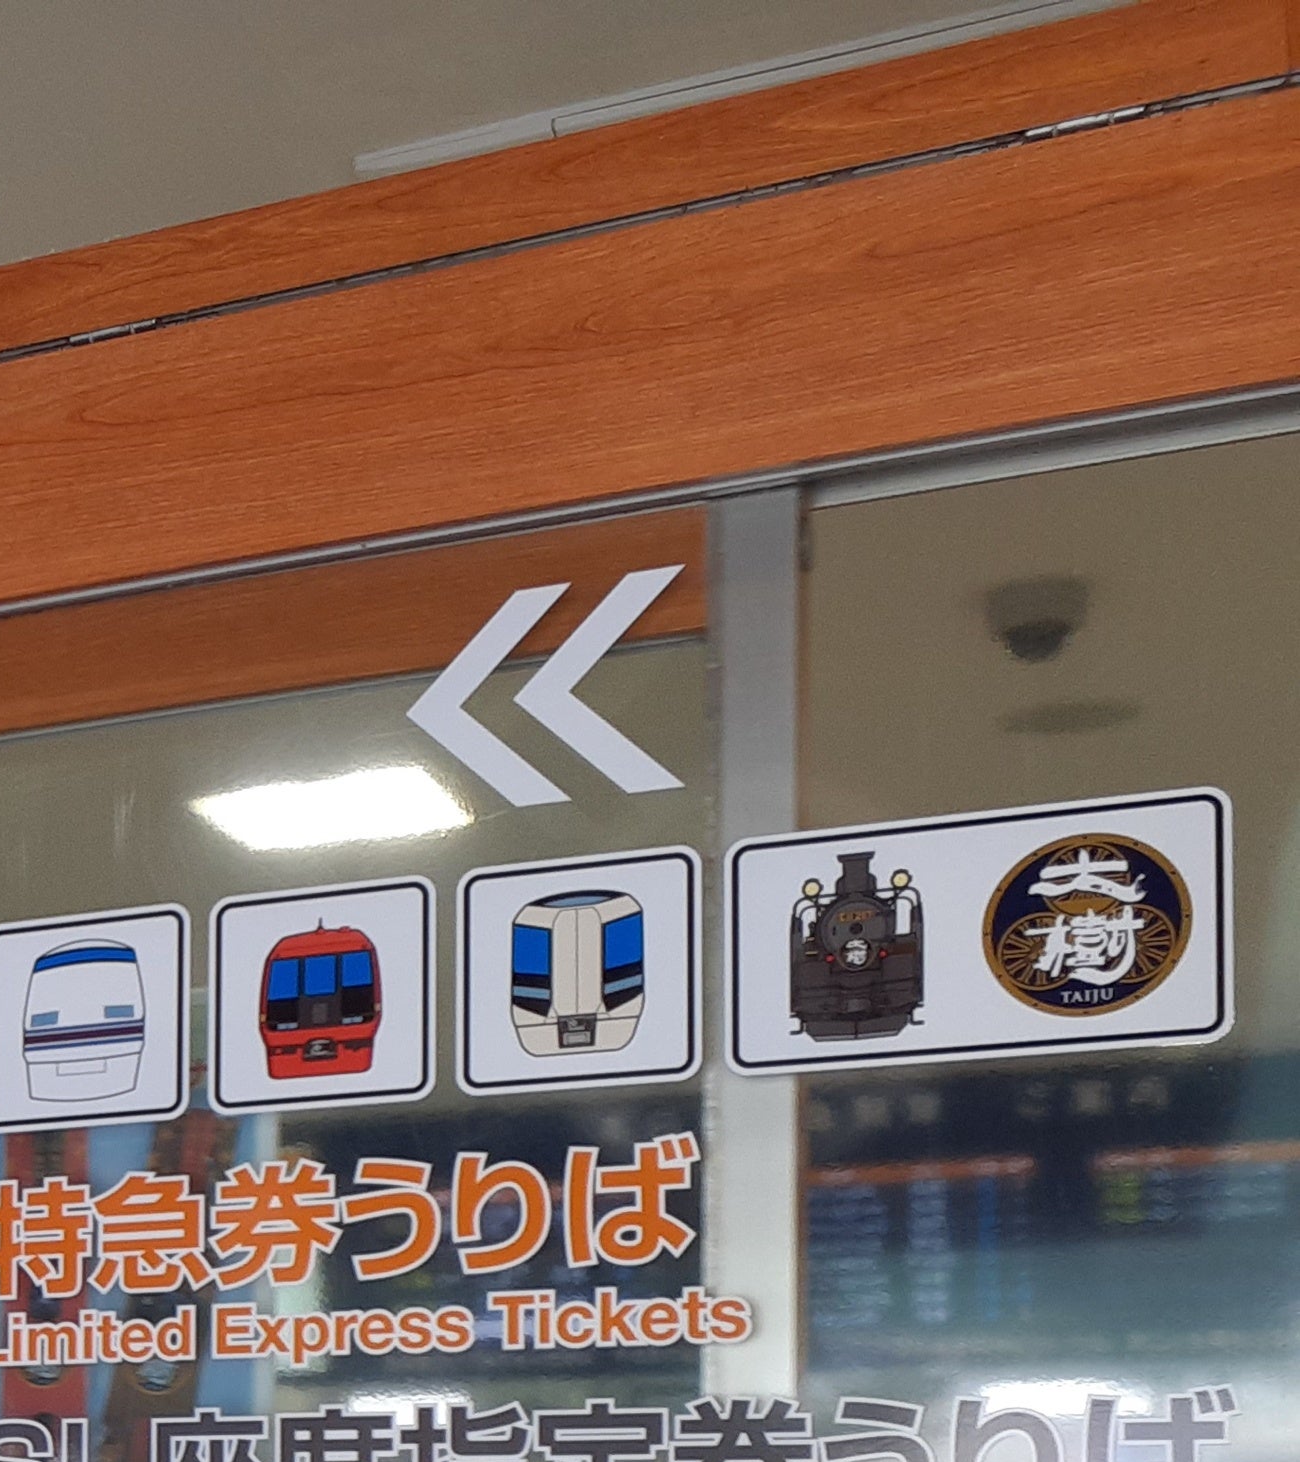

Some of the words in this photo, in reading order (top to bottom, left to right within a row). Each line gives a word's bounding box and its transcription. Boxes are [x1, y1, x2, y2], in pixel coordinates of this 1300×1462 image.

[1061, 987, 1115, 1004] TAIJU
[214, 1297, 473, 1363] Express
[488, 1284, 751, 1349] Tickets
